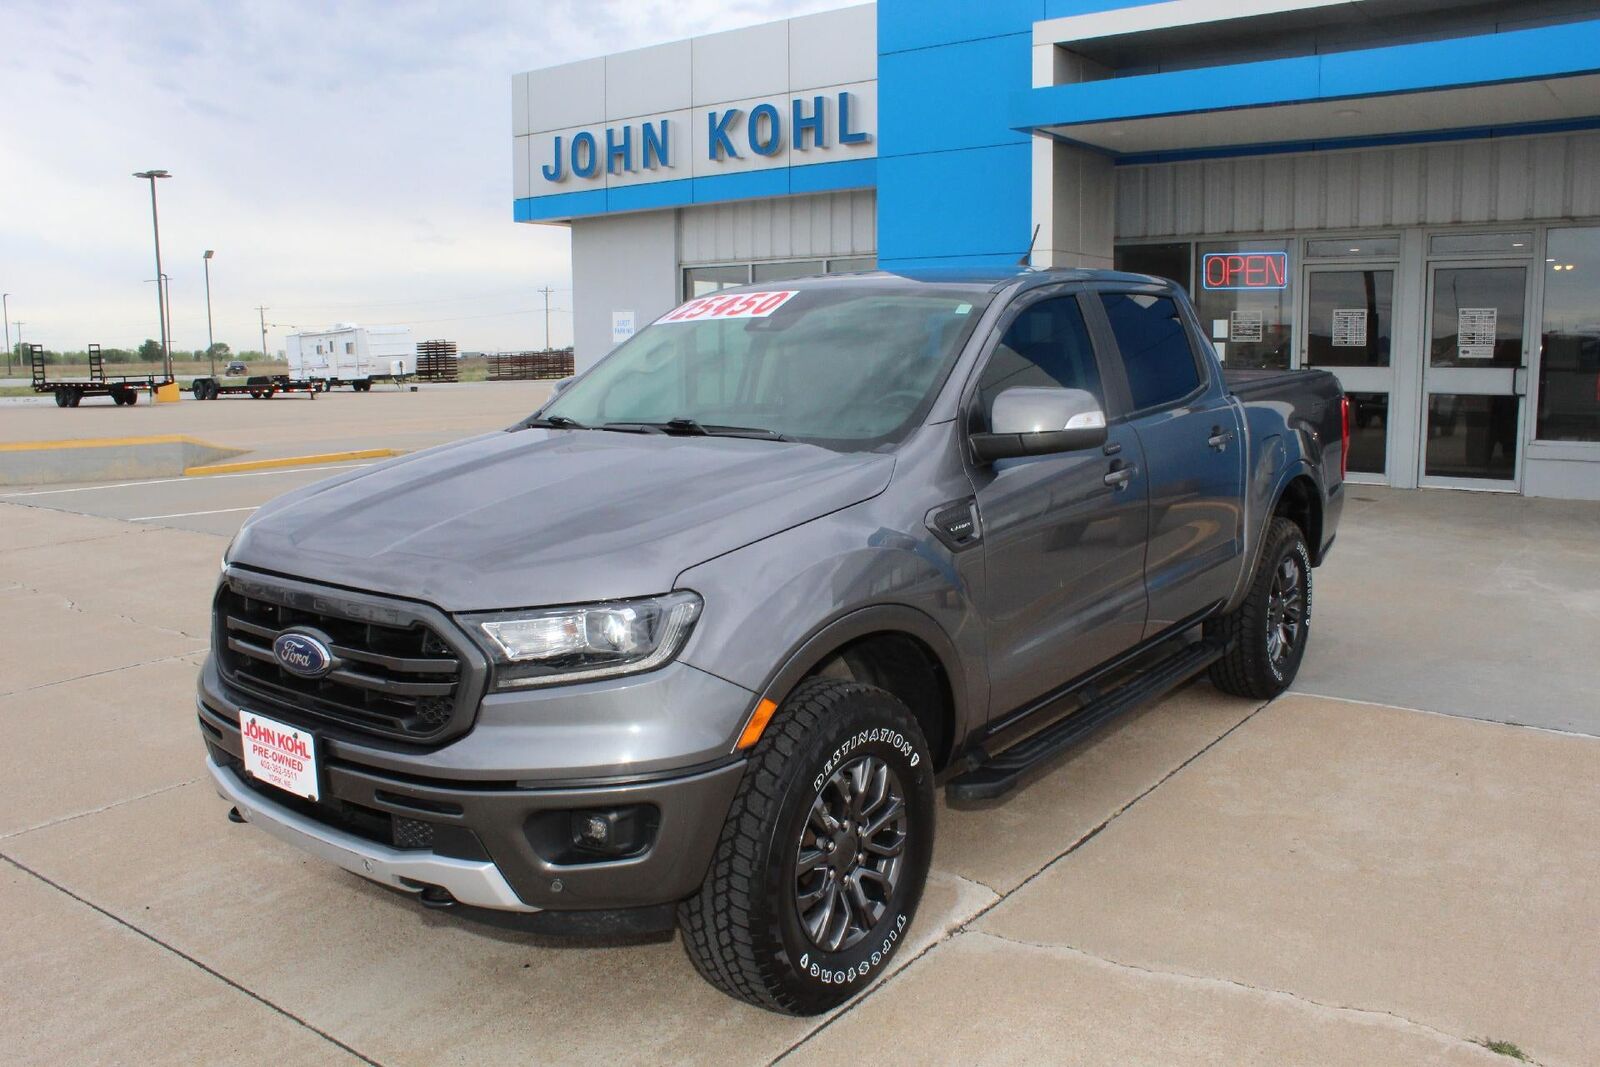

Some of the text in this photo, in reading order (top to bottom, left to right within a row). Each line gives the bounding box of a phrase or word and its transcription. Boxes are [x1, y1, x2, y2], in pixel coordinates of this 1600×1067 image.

[542, 92, 872, 183] JOHN KOHL
[1206, 255, 1285, 286] OPEN
[281, 640, 312, 667] Ford
[244, 721, 312, 760] JOHN KOHL
[252, 743, 304, 773] PRE-OWNED
[813, 728, 913, 792] DESTINATION
